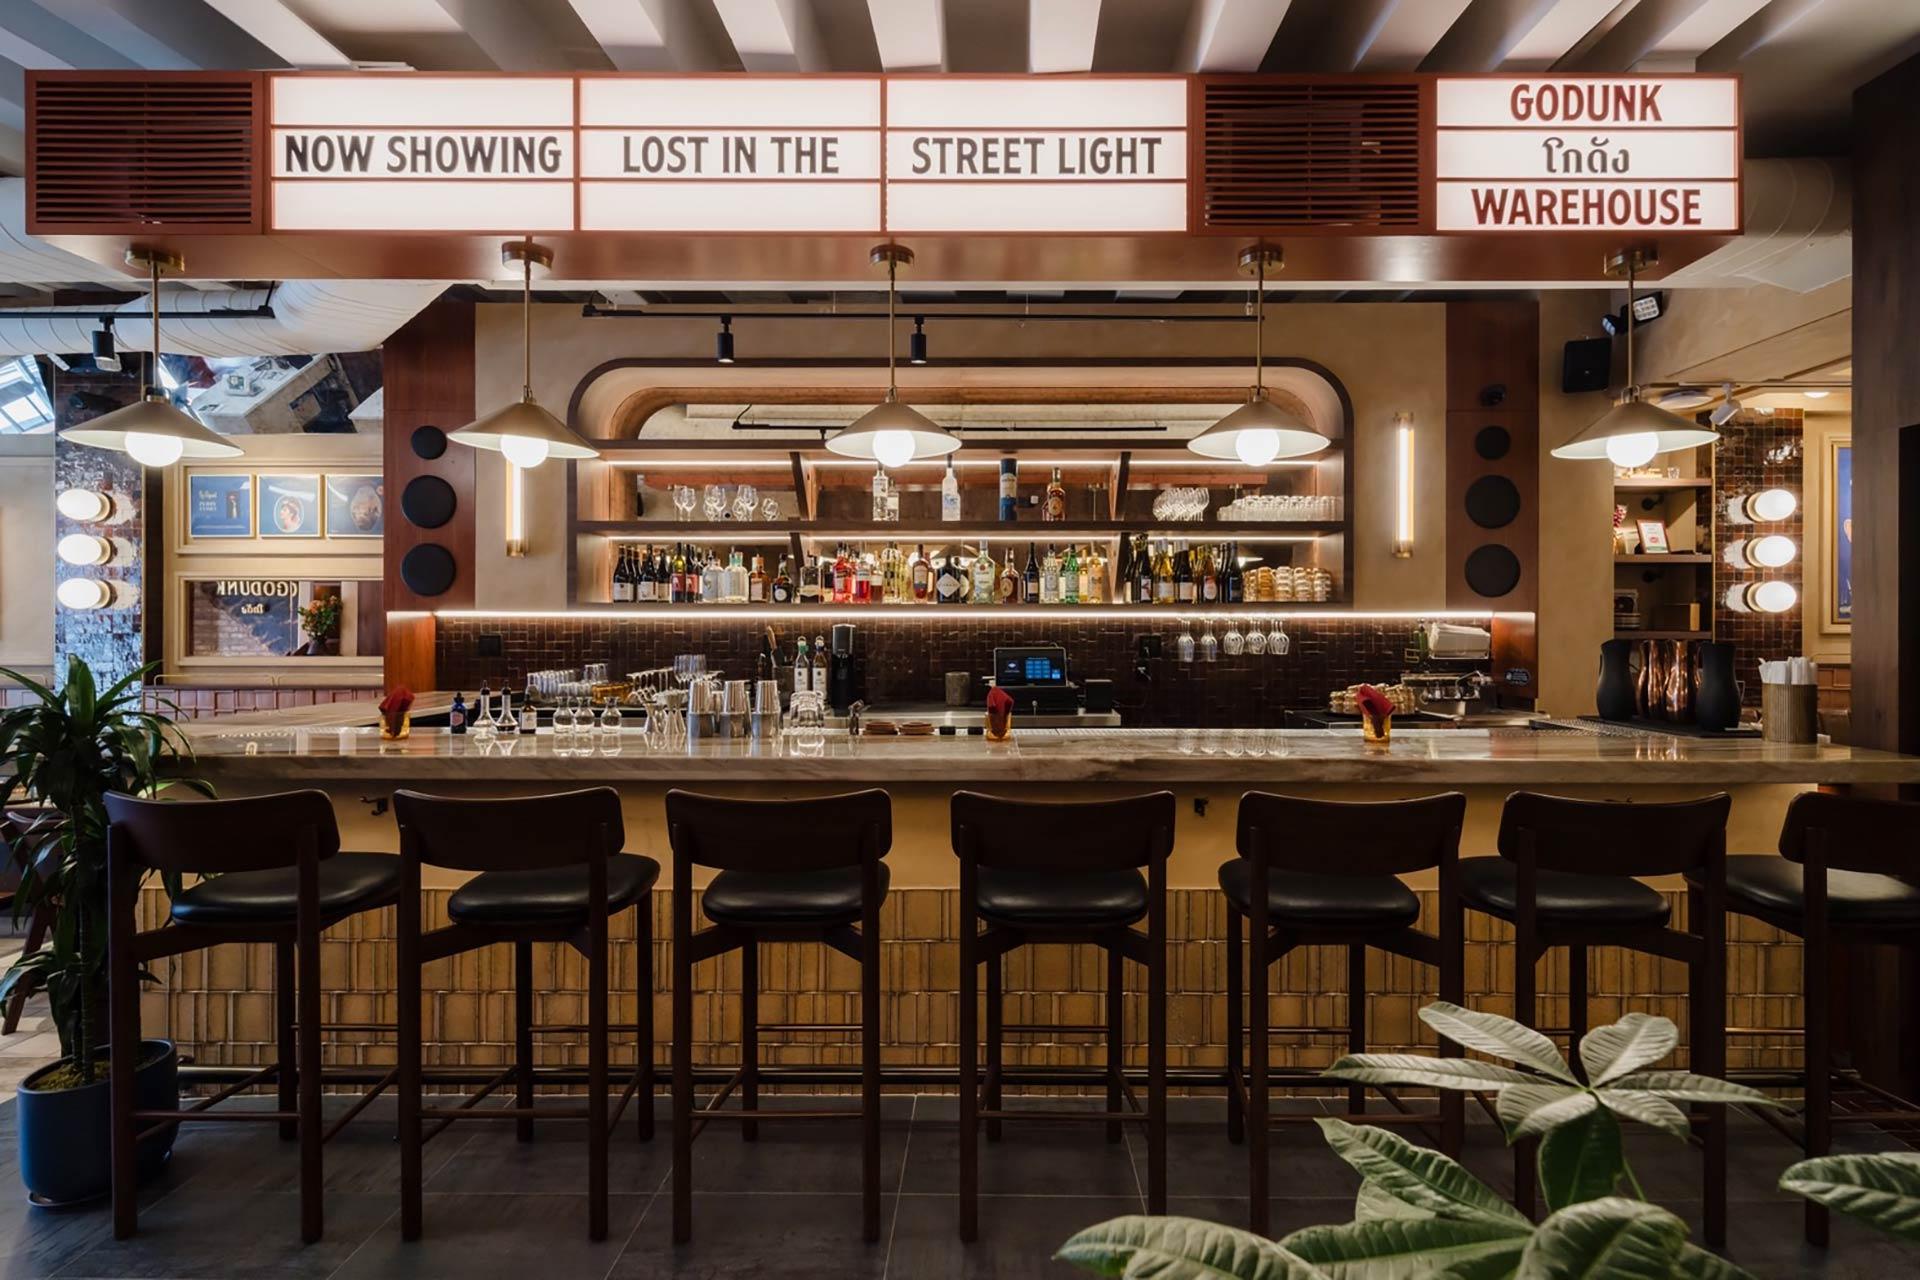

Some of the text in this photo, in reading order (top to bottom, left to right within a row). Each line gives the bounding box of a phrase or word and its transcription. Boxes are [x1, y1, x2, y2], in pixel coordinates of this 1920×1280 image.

[1510, 83, 1662, 122] GODUNK
[285, 135, 562, 173] NOW SHOWING
[623, 136, 839, 174] LOST IN THE
[912, 137, 1162, 175] STREET LIGHT
[1542, 136, 1630, 174] โกดัง
[1471, 188, 1702, 226] WAREHOUSE
